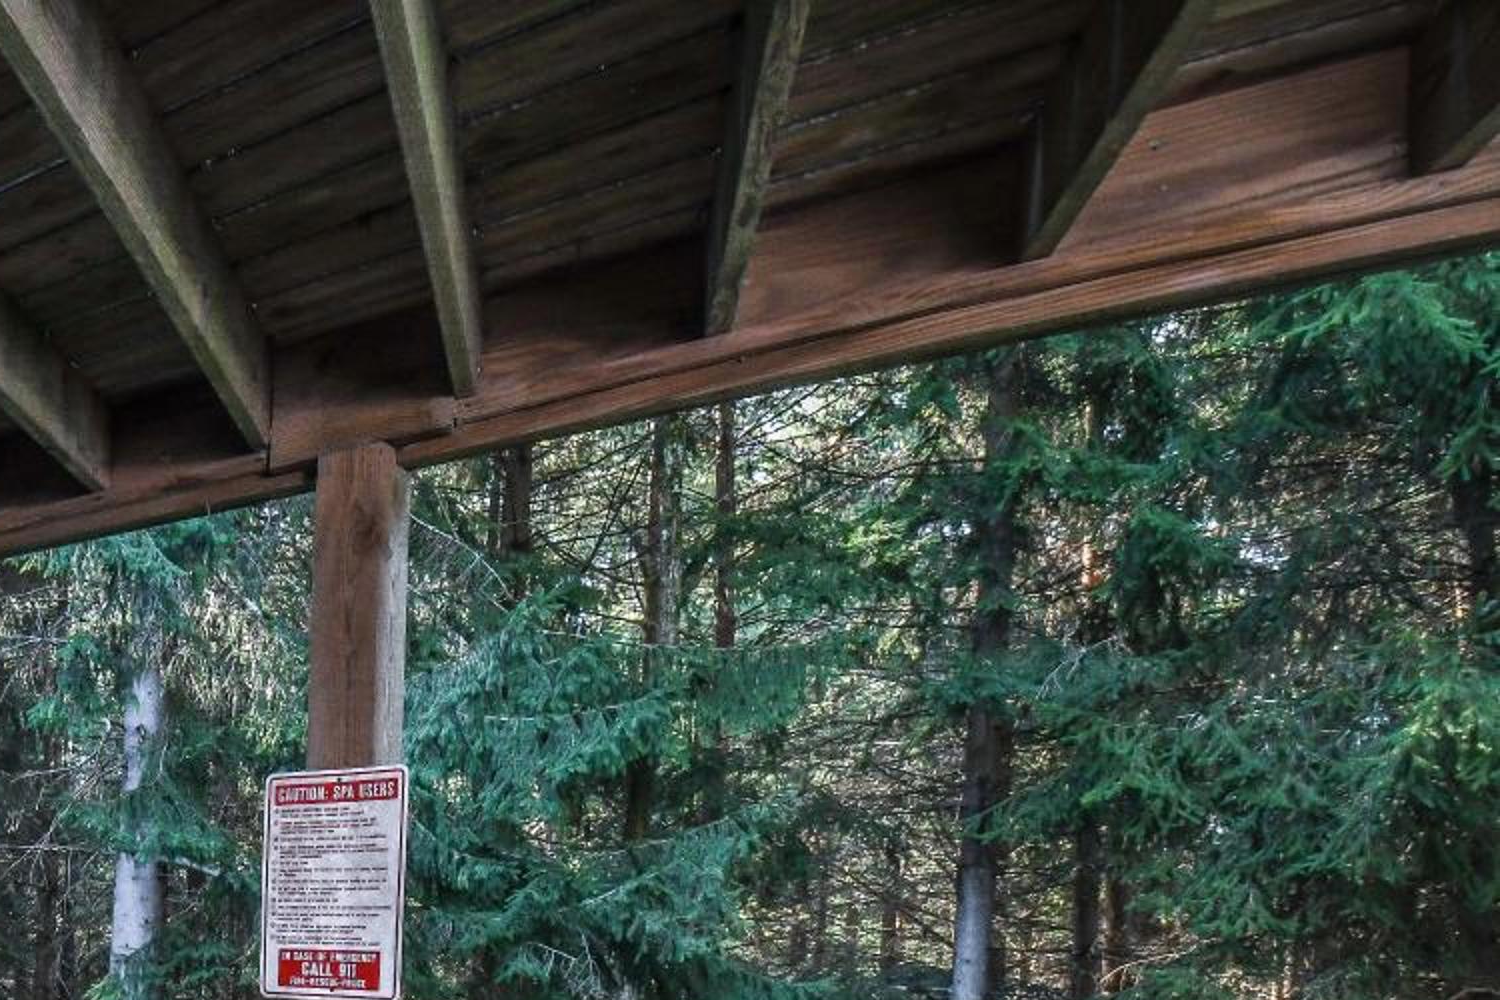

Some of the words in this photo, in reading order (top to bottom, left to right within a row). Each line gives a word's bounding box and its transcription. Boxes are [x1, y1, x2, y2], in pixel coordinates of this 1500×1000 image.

[333, 785, 354, 799] SPA
[359, 782, 395, 797] USERS
[301, 961, 332, 977] CALL
[340, 963, 357, 978] 911
